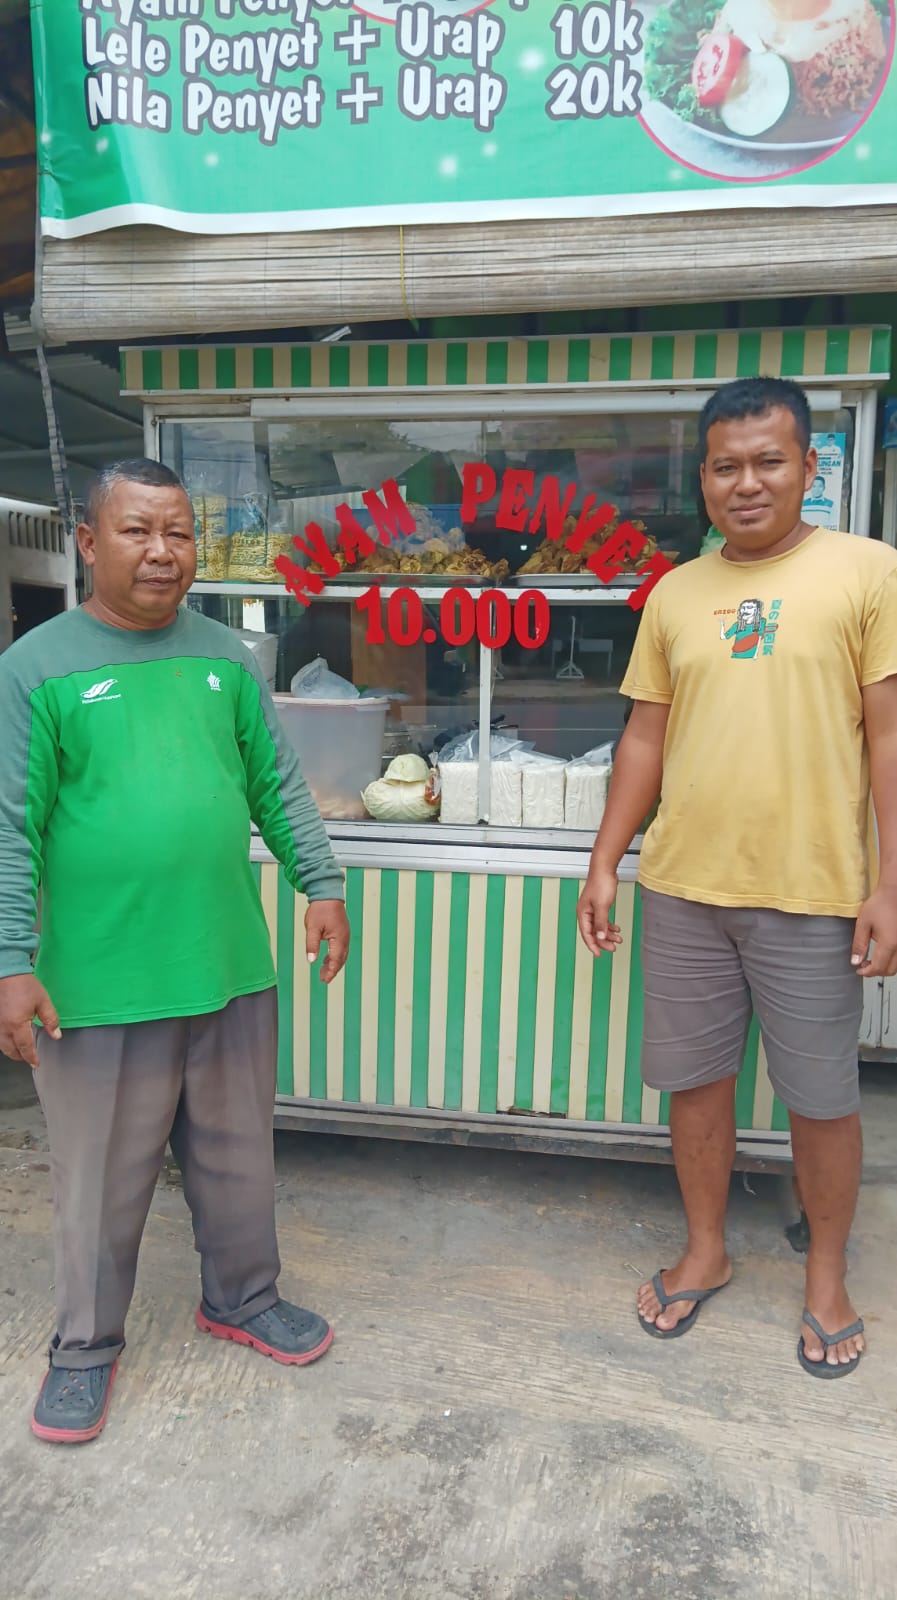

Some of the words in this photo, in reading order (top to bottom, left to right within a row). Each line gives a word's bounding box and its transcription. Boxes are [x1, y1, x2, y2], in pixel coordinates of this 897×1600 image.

[83, 14, 168, 75] Lele
[182, 19, 321, 87] Penyet
[335, 16, 379, 65] +
[398, 4, 504, 70] Urap
[551, 0, 642, 58] 10k
[86, 70, 170, 133] Nila
[184, 76, 324, 145] Penyet
[338, 73, 381, 123] +
[400, 63, 506, 131] Urap
[546, 56, 641, 119] 20k
[274, 478, 417, 607] AYAM
[459, 462, 675, 612] PENYET
[355, 585, 550, 648] 10.000
